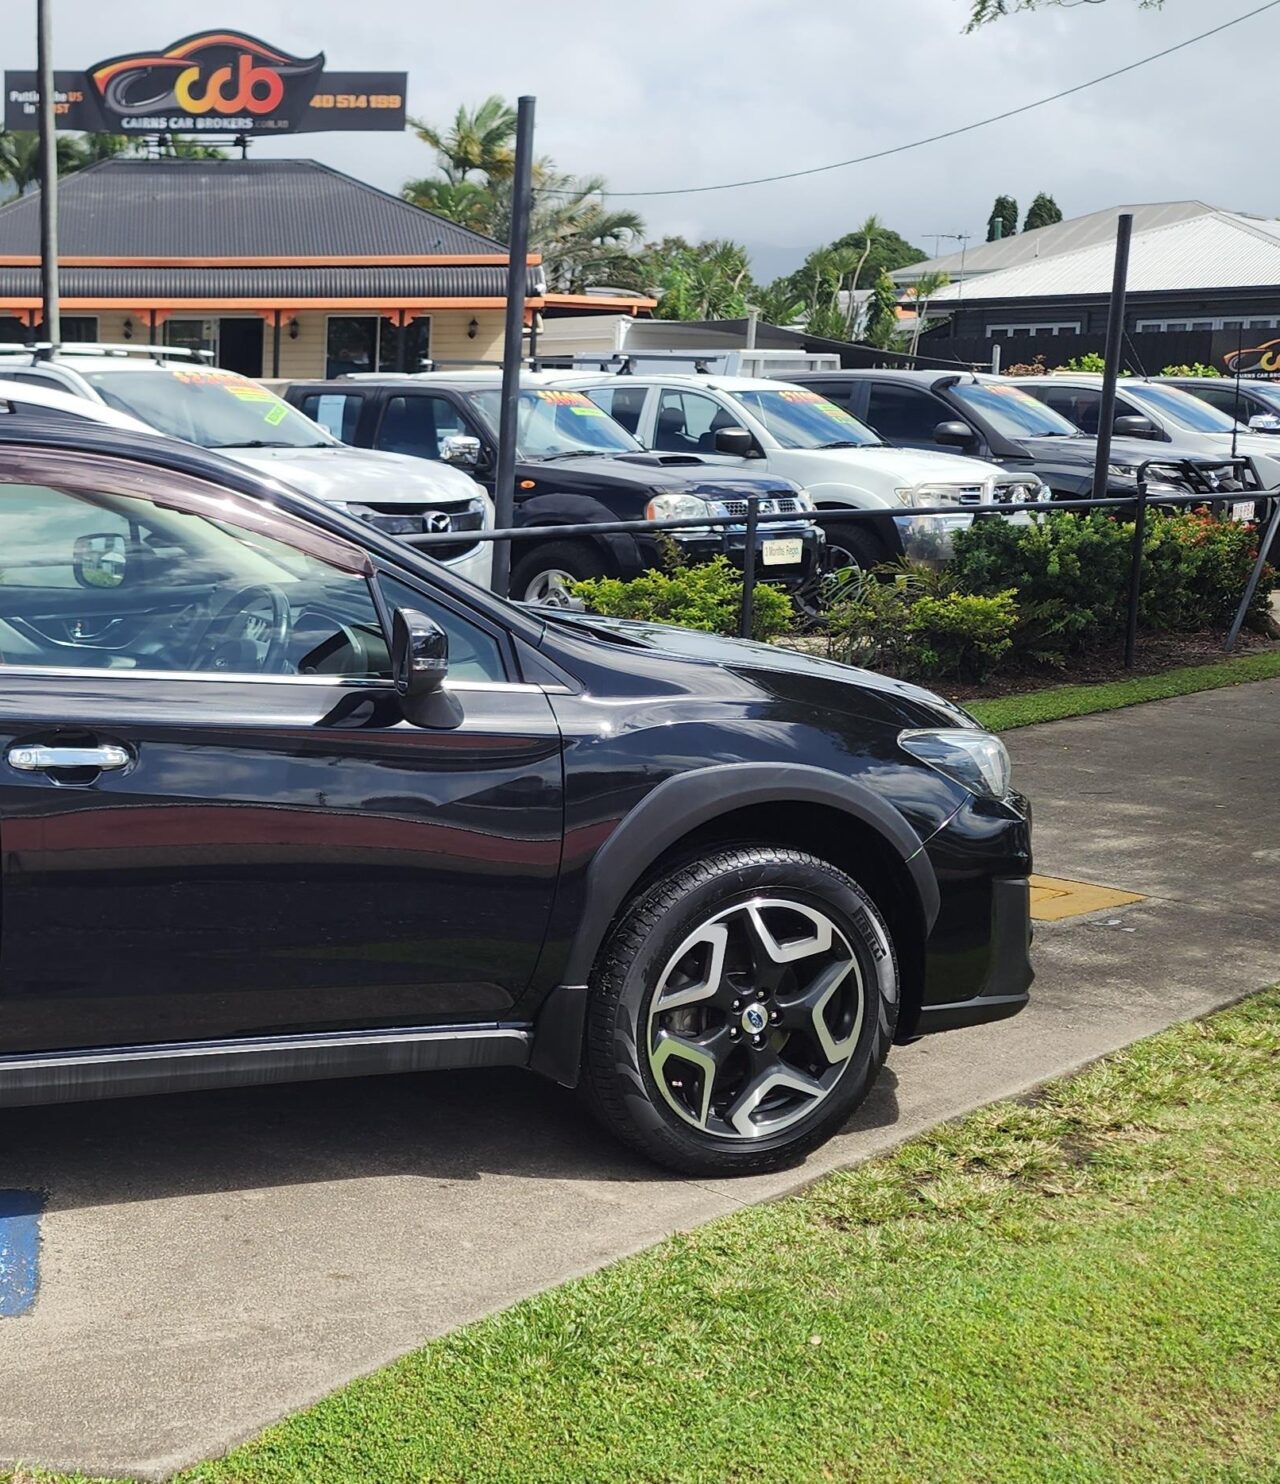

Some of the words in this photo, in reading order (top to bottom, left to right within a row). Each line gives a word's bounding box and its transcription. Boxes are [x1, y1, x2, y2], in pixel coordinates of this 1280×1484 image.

[174, 54, 284, 114] ccb
[309, 94, 335, 108] 40
[335, 94, 368, 108] 514
[369, 94, 402, 108] 199
[121, 117, 168, 130] CAIRNS
[169, 117, 194, 129] CAR
[195, 117, 254, 129] BROKERS
